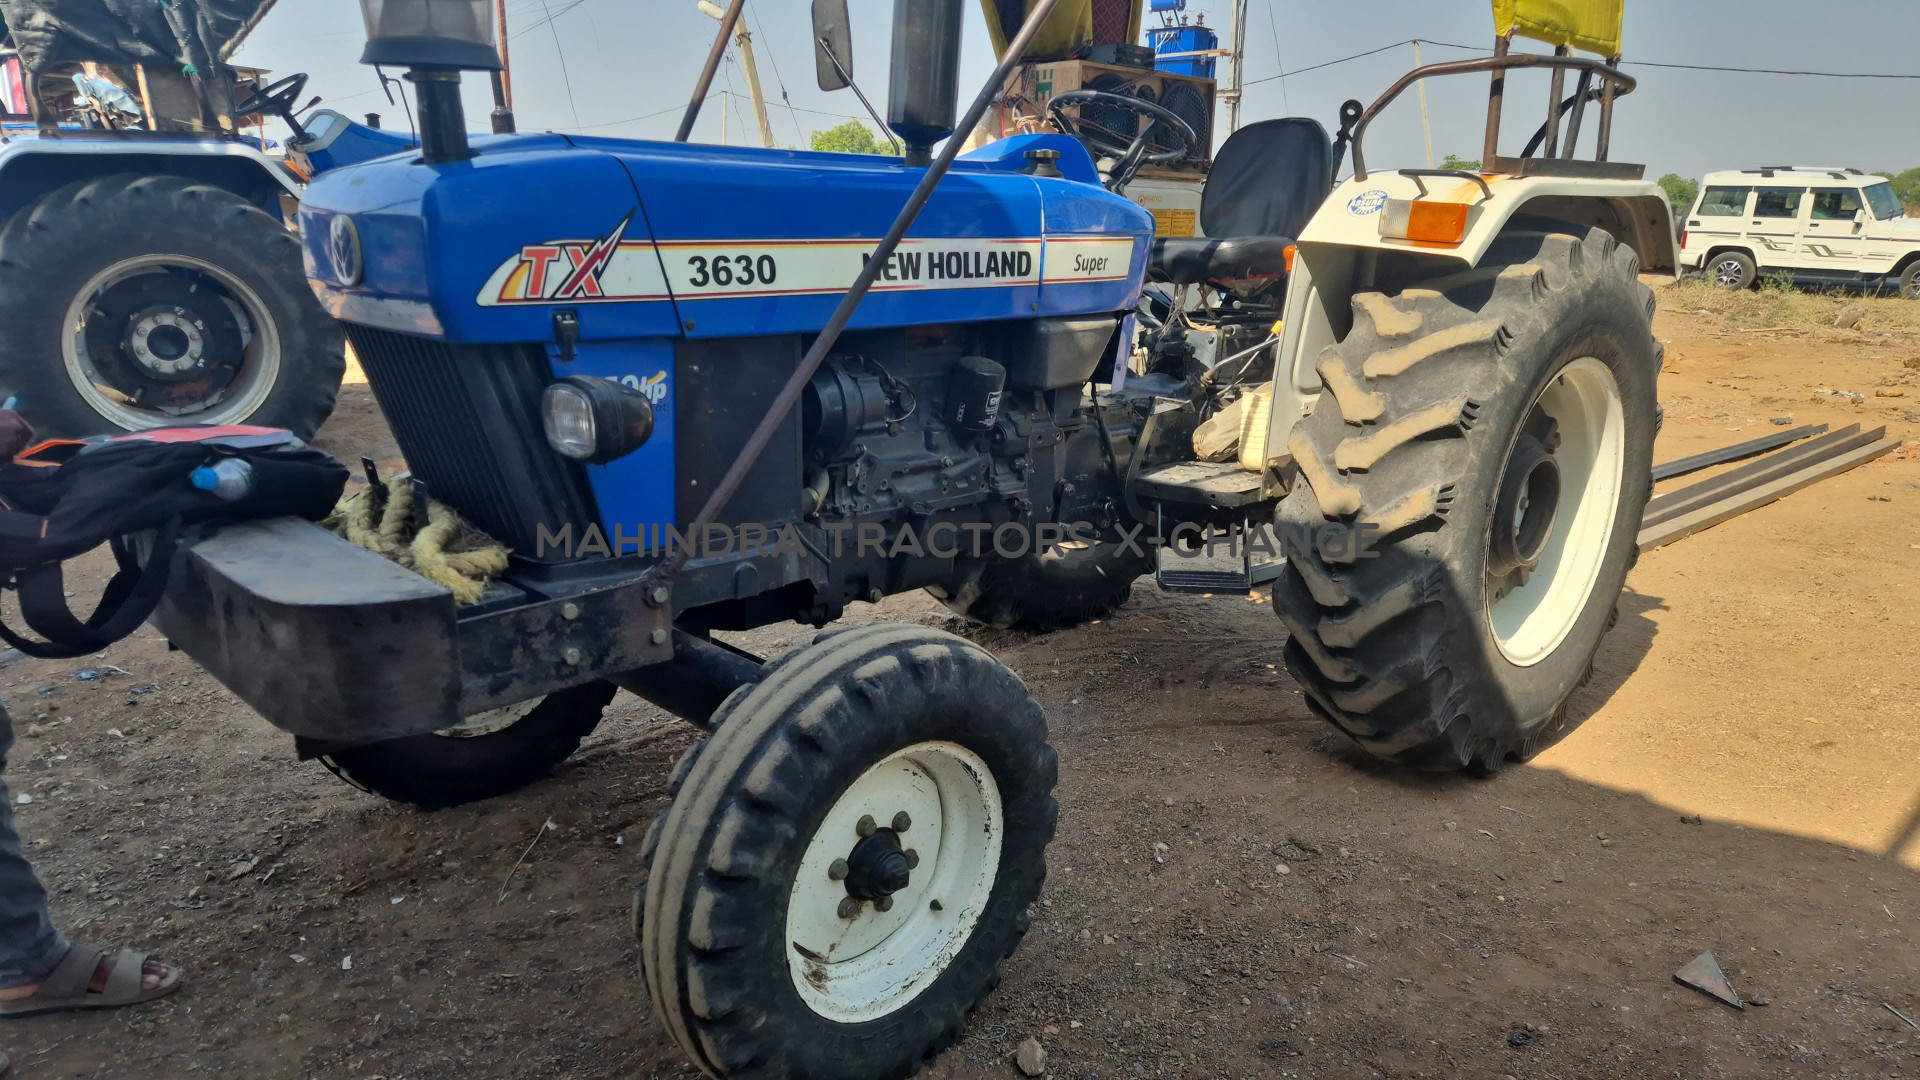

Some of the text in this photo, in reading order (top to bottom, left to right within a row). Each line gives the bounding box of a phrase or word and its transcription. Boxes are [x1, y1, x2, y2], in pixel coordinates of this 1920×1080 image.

[519, 206, 637, 299] TX
[928, 251, 1032, 280] HOLLAND
[1073, 253, 1109, 276] Super
[687, 254, 777, 287] 3630
